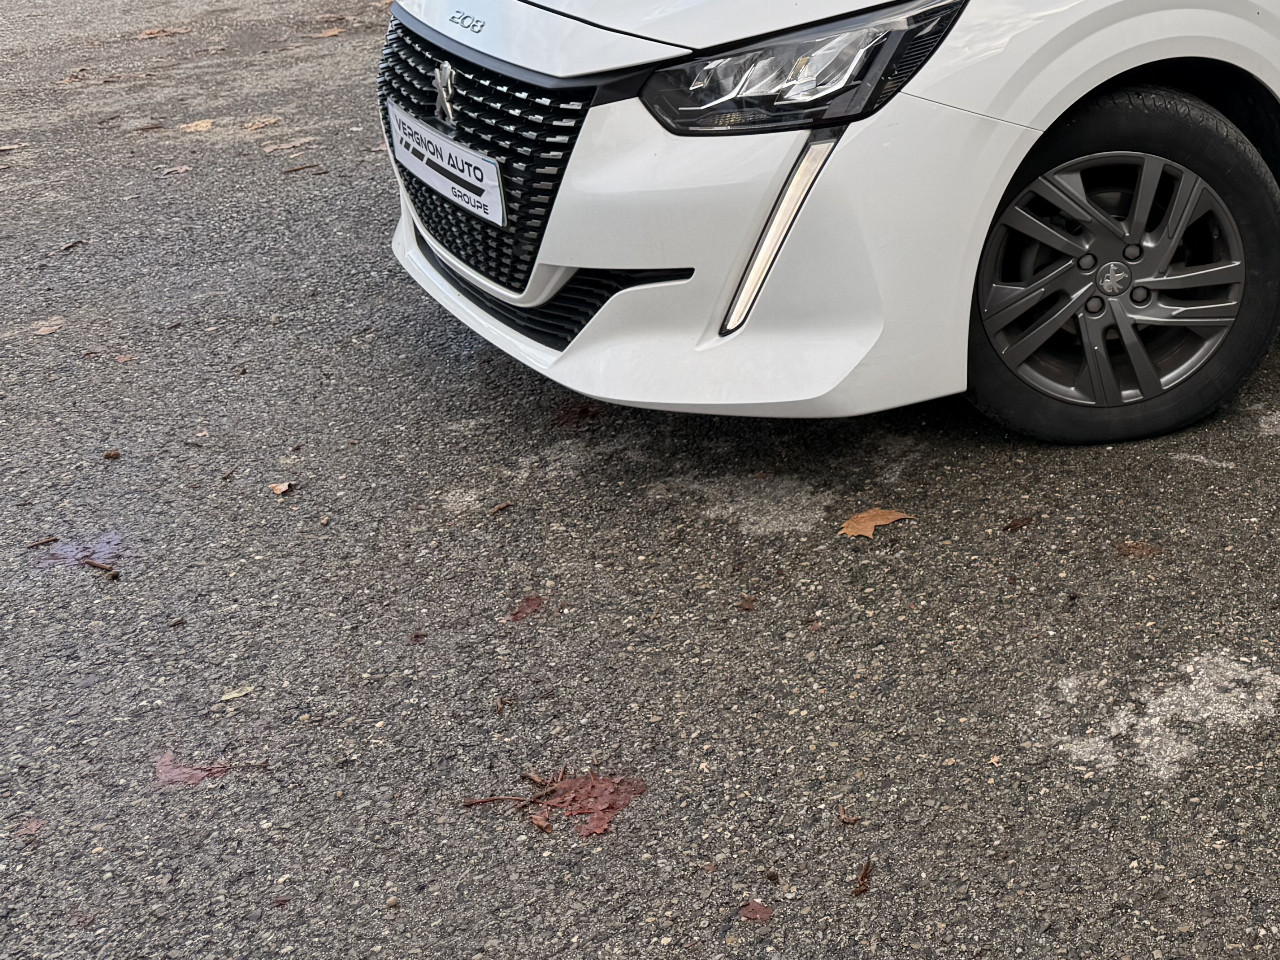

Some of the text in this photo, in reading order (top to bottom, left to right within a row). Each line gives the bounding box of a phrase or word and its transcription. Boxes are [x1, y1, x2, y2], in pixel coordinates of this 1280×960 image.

[449, 10, 485, 33] 208
[395, 114, 484, 183] VERGNON AUTO
[451, 186, 490, 215] GROUPE
